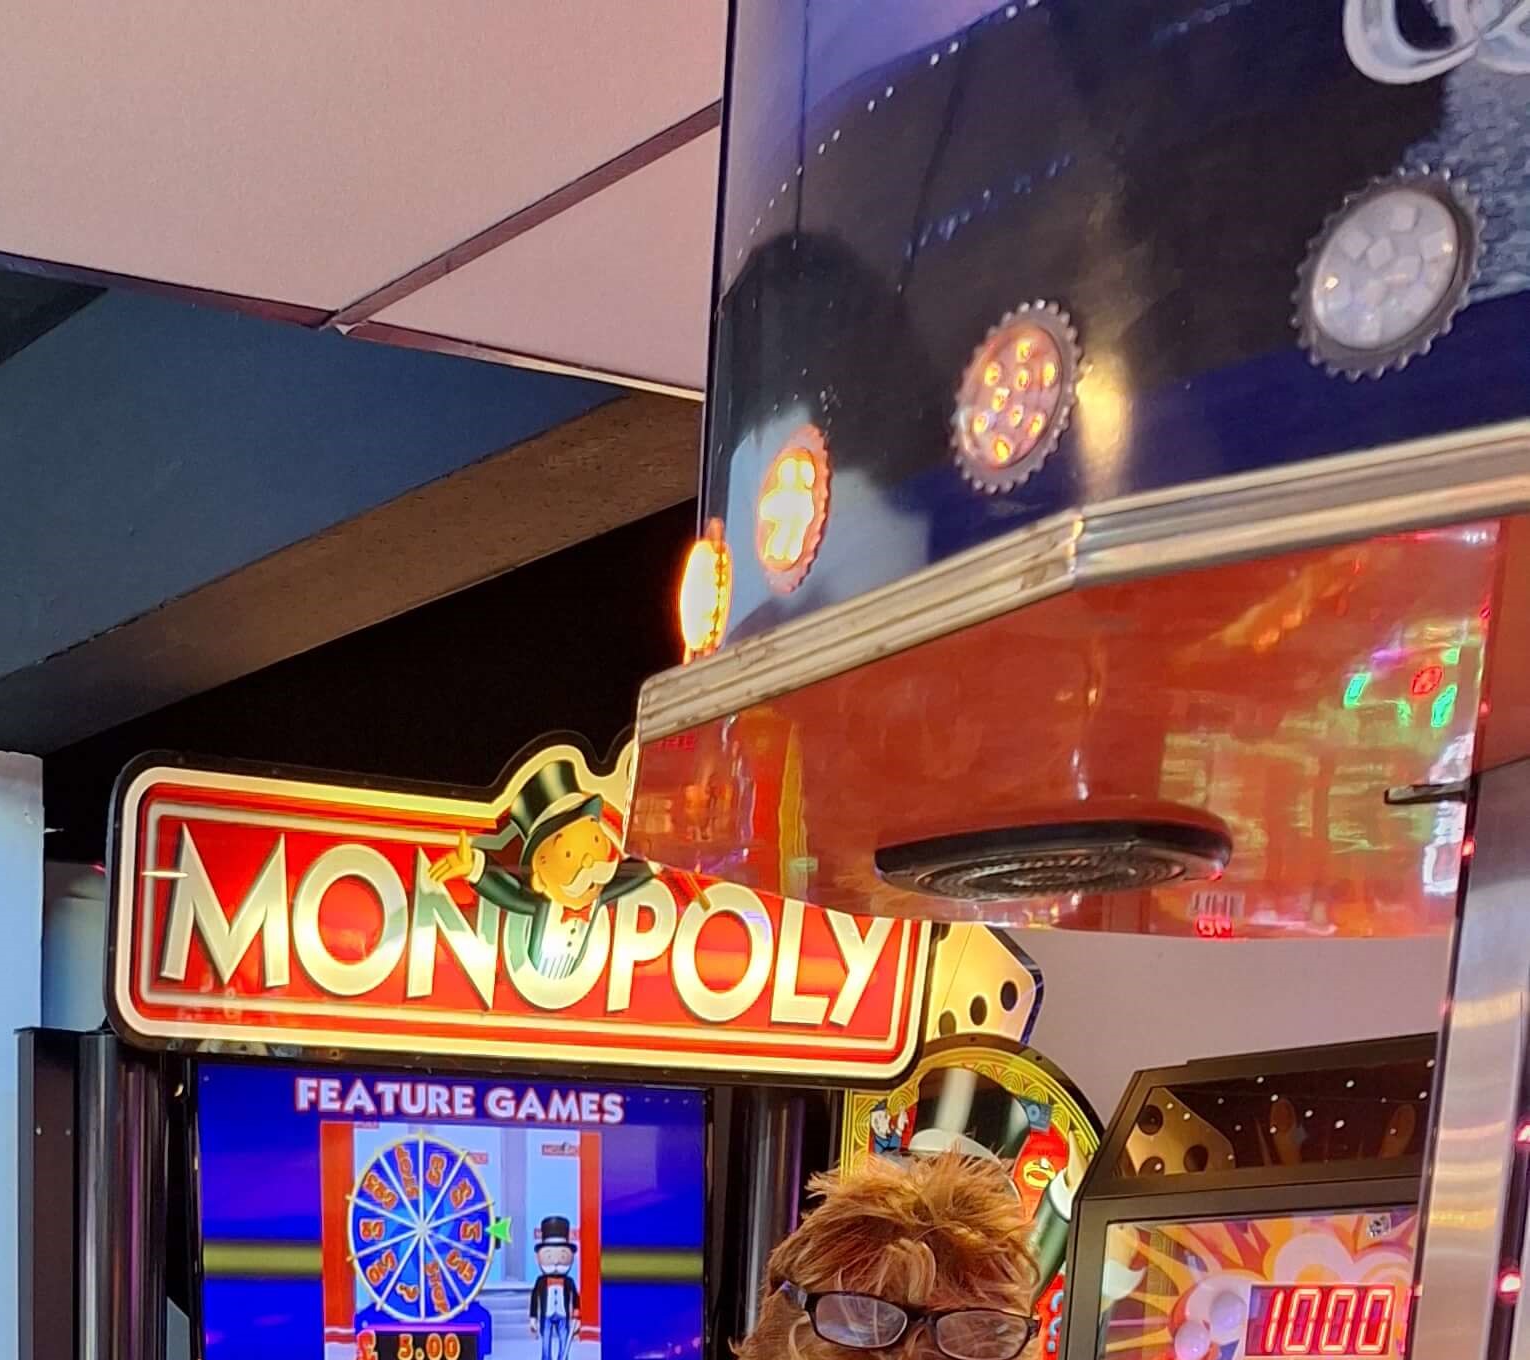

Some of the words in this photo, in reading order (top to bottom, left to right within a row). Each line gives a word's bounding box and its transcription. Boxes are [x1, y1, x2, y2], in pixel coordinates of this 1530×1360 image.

[160, 822, 891, 1027] MONOPOLY
[295, 1077, 475, 1116] FEATURE
[484, 1087, 625, 1124] GAMES
[1265, 1288, 1393, 1354] 1000
